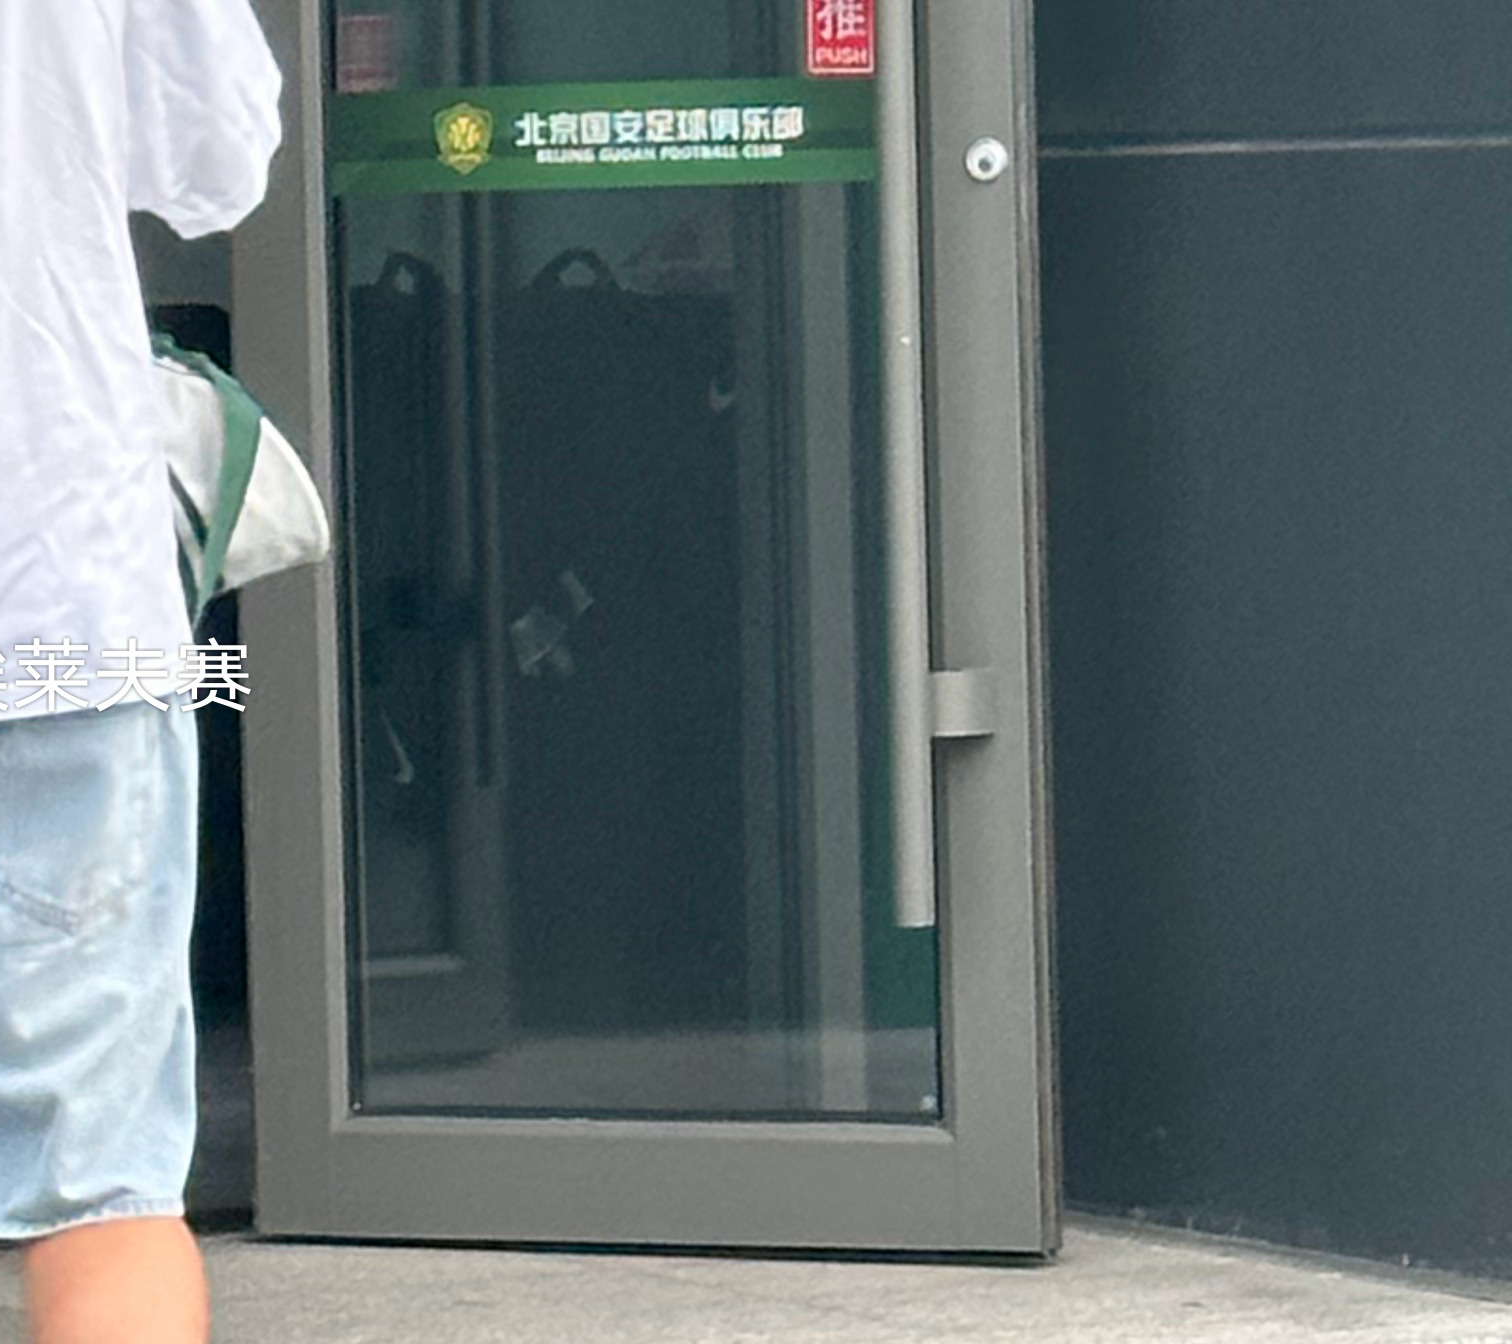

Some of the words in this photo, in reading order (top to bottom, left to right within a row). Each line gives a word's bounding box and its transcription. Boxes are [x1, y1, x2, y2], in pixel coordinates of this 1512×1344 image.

[815, 47, 867, 65] PUSH
[515, 106, 804, 146] 北京国安足球俱乐部
[536, 148, 595, 163] BEIJING
[599, 147, 656, 162] GUOAN
[660, 145, 737, 161] FOOTBALL
[742, 144, 783, 159] CLUB
